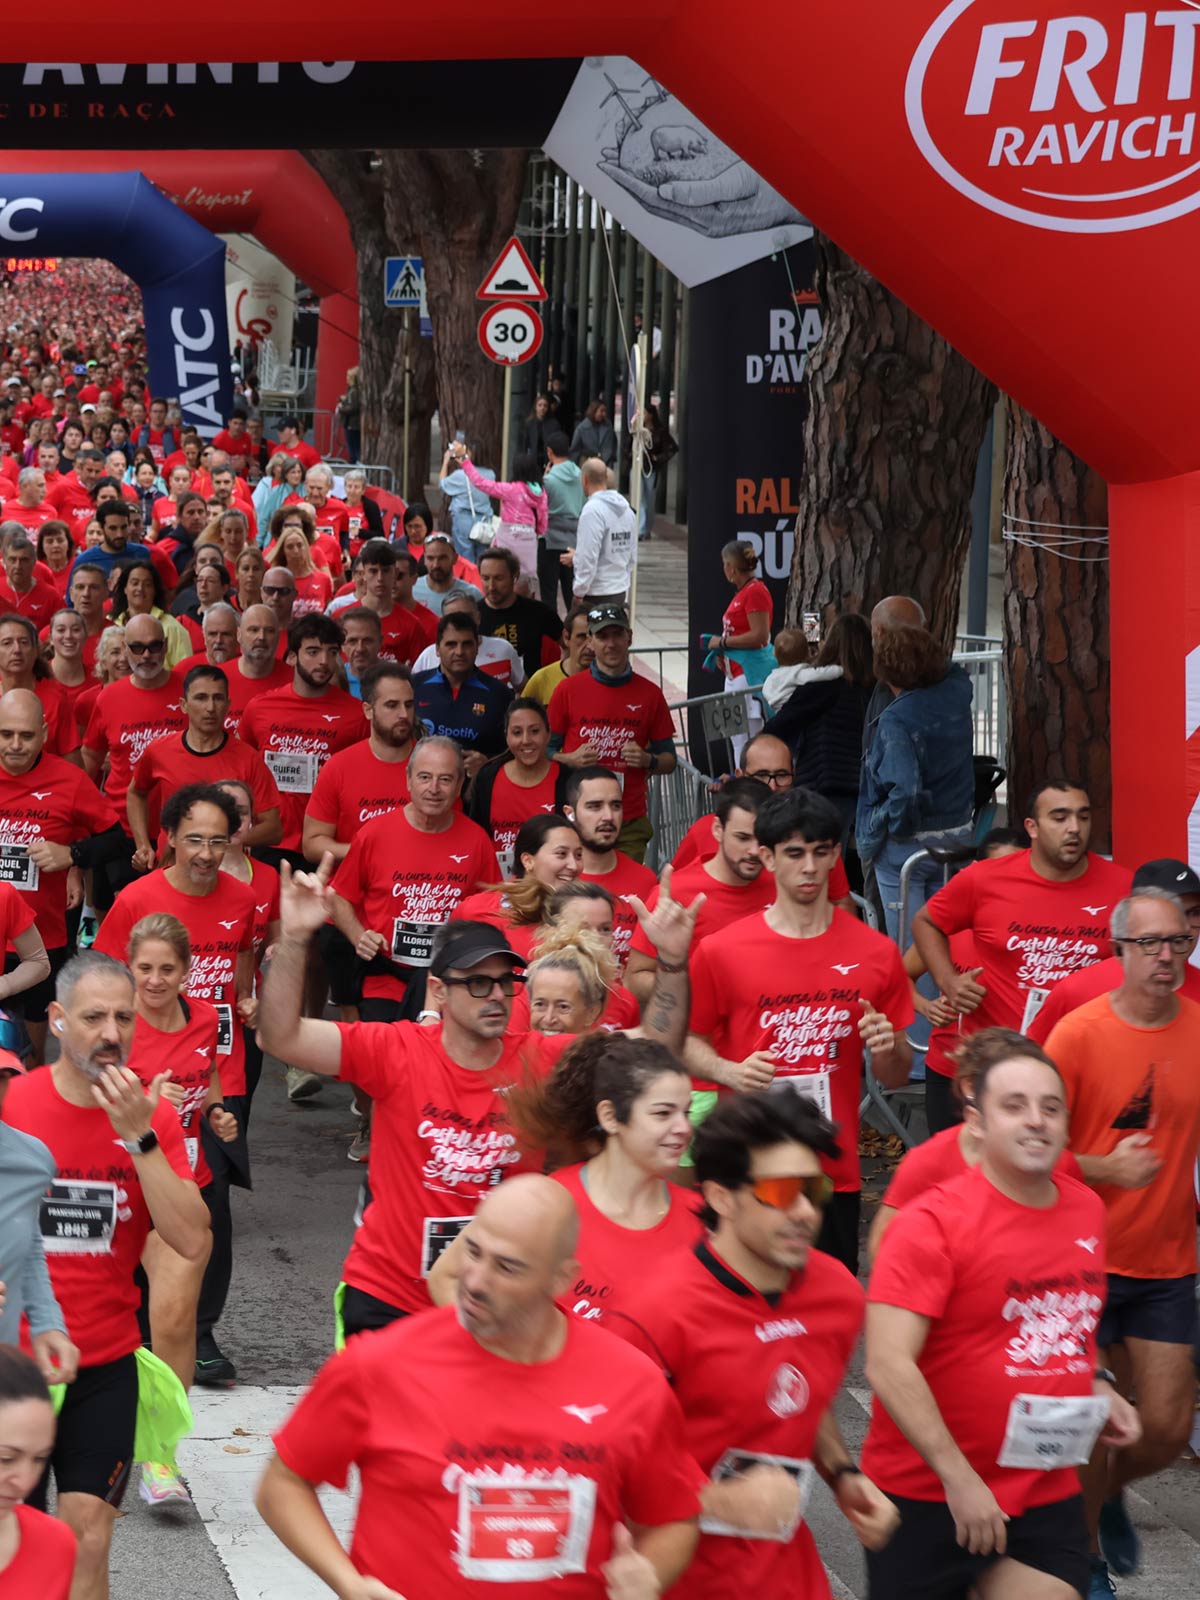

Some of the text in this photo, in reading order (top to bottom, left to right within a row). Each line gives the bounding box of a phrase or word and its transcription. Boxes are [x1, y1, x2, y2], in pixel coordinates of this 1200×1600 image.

[29, 103, 68, 118] DE
[88, 103, 177, 120] RAÇA
[988, 113, 1196, 167] RAVICH
[494, 324, 527, 343] 30
[711, 704, 743, 730] CPS
[438, 725, 479, 740] Spotify
[392, 883, 431, 898] Castell
[1007, 935, 1098, 955] Castell d'Aro
[1022, 952, 1065, 971] Platja
[760, 1005, 850, 1029] Castell d'Aro
